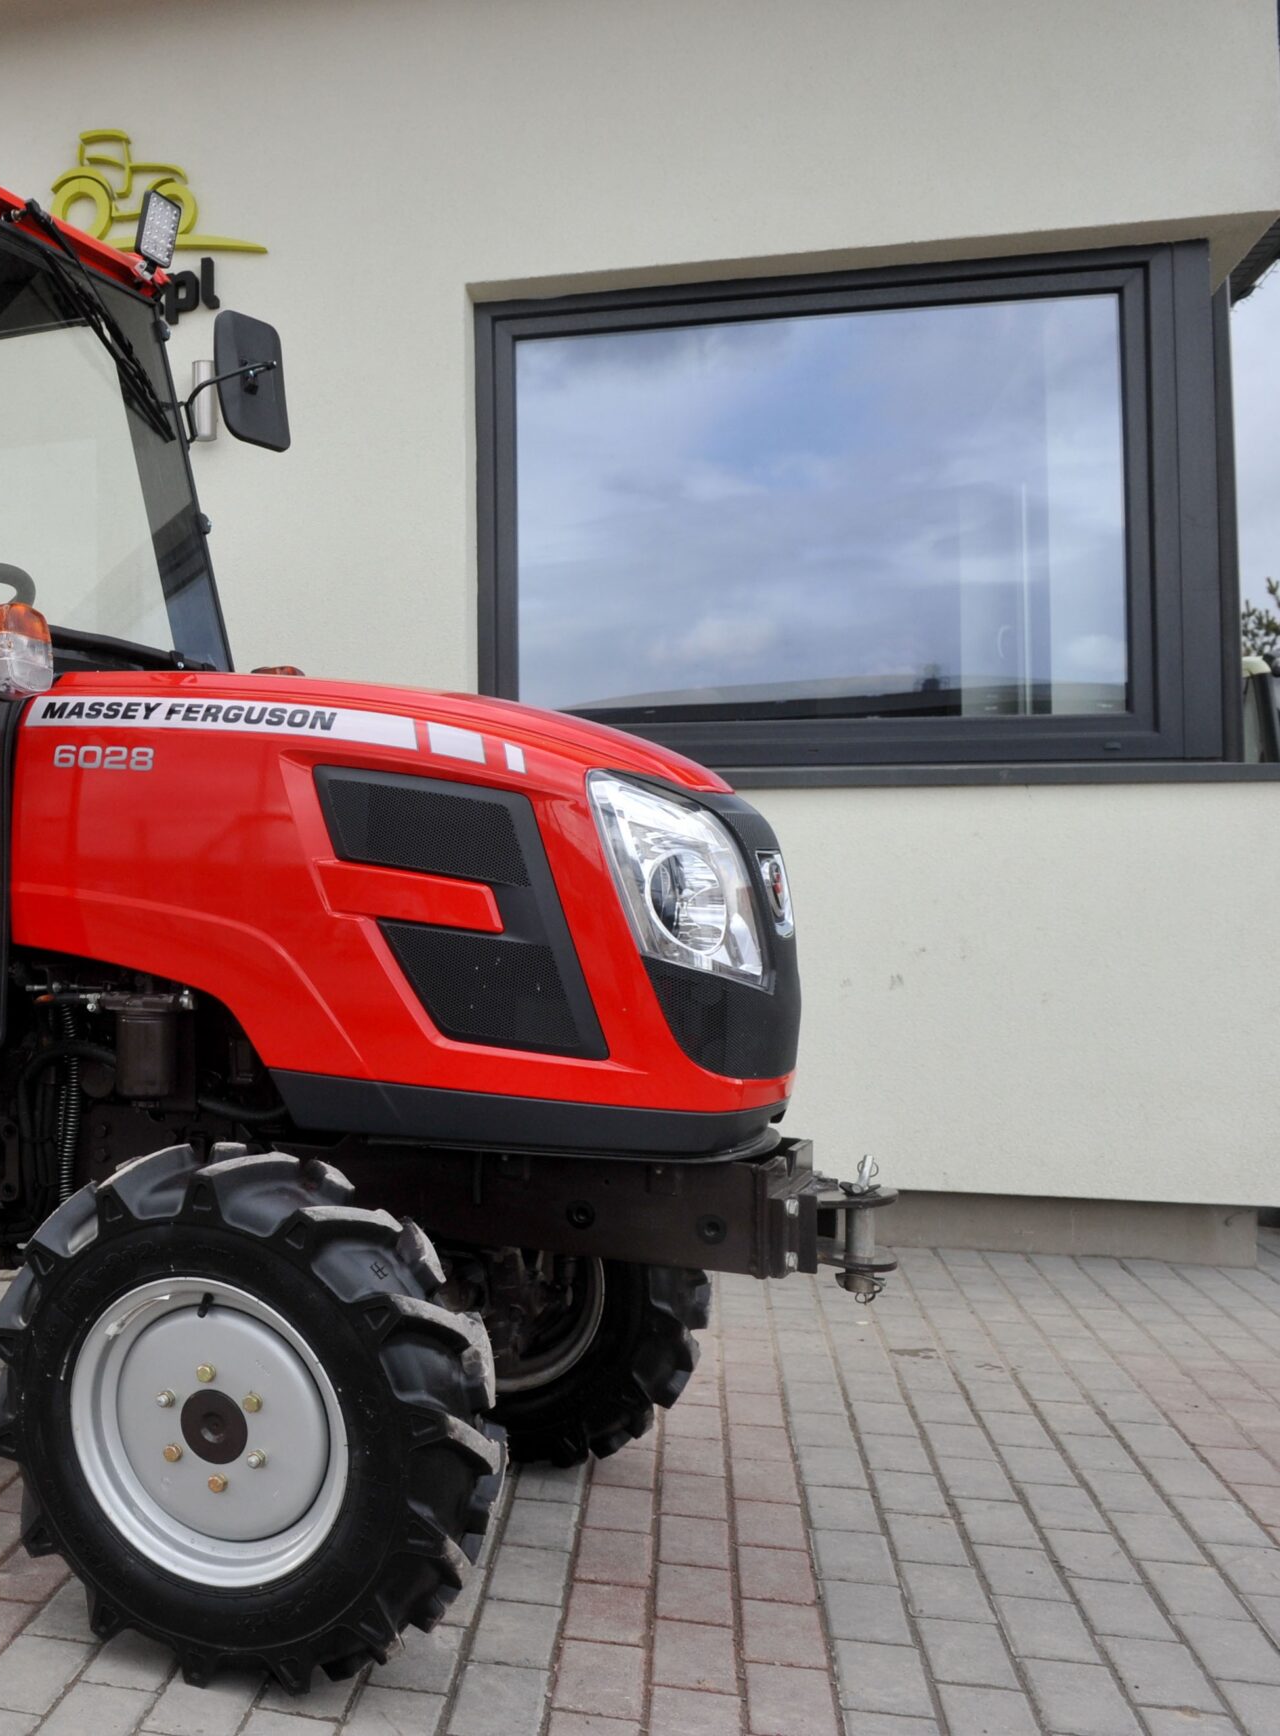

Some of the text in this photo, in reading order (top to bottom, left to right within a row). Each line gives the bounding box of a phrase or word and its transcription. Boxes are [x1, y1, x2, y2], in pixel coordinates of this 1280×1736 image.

[41, 702, 337, 731] MASSEY FERGUSON
[53, 745, 154, 771] 6028
